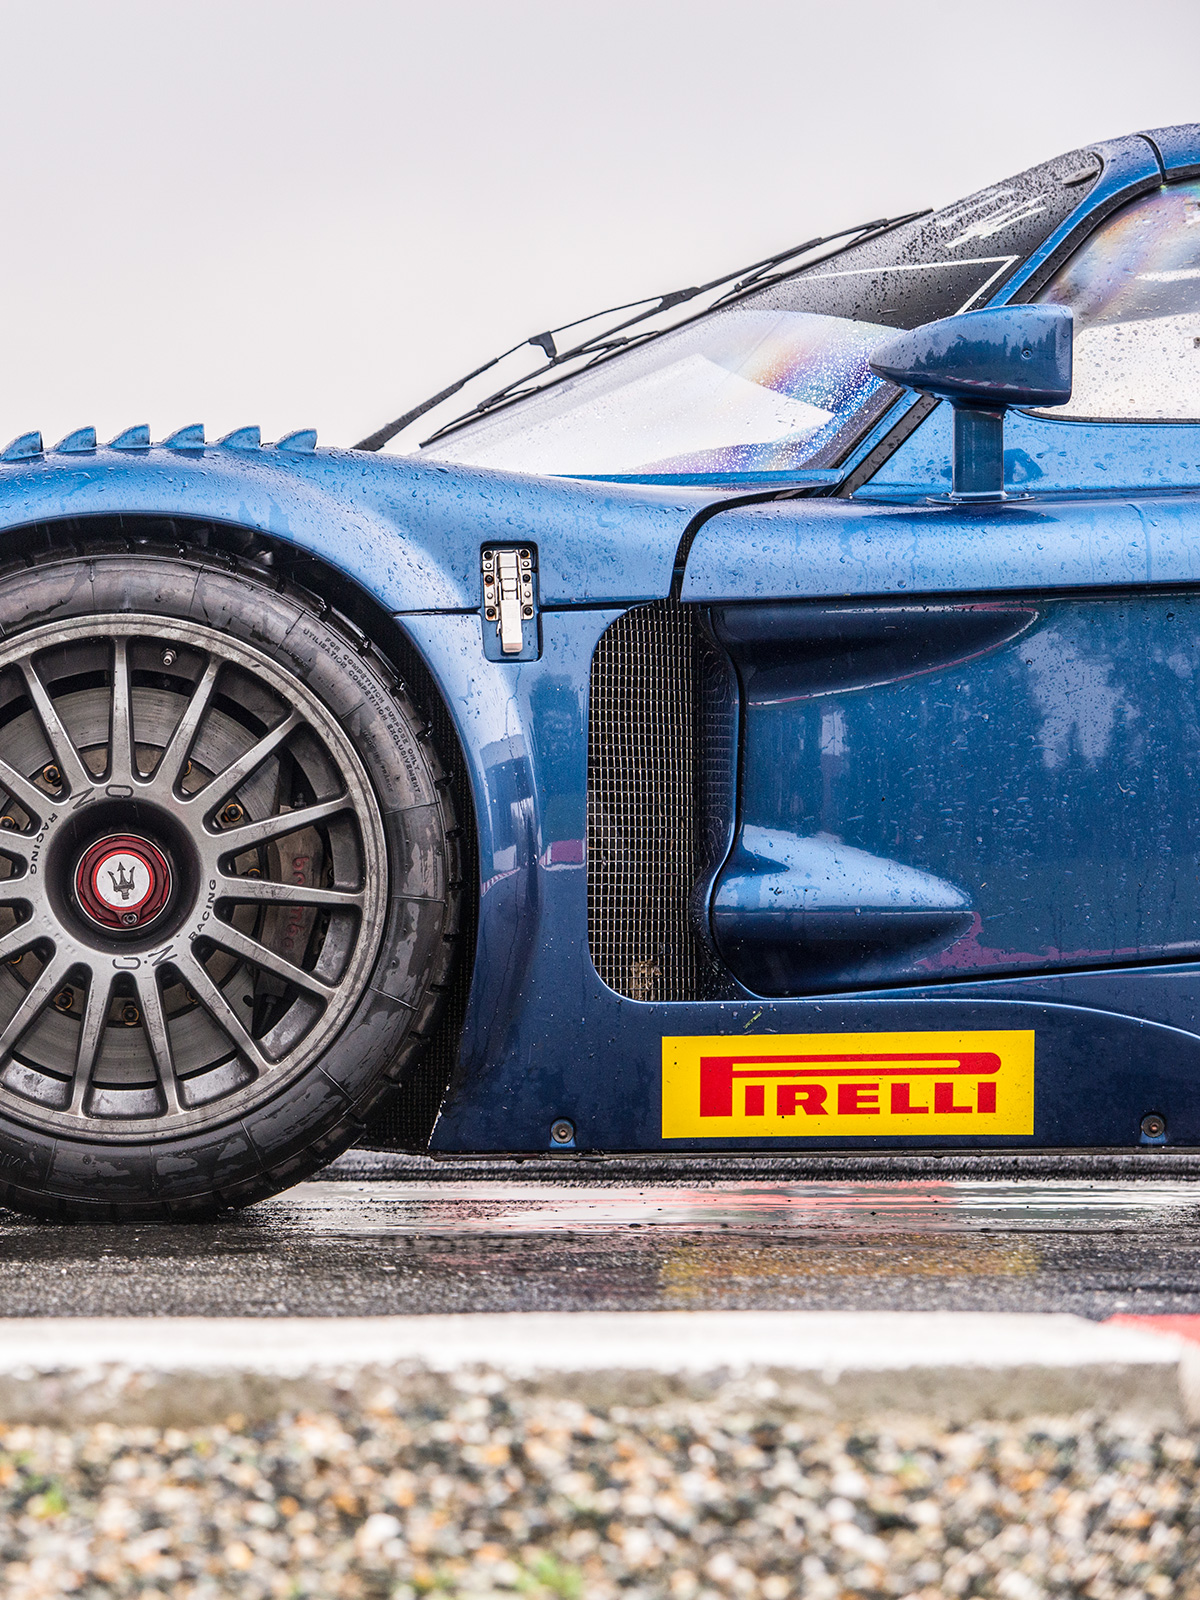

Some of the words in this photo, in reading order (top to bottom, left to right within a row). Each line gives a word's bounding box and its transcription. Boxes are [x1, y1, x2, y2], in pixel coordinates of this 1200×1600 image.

[303, 629, 347, 669] UTILISATION
[349, 670, 388, 721] COMPETITION
[387, 724, 421, 793] EXCLUSIVEMENT
[325, 637, 341, 652] FOR
[343, 654, 385, 704] COMPETITION
[384, 706, 409, 745] PURPOSE
[408, 748, 420, 770] ONLY
[30, 812, 58, 875] RACING
[188, 879, 217, 941] RACING
[700, 1052, 1002, 1117] PIRELLI
